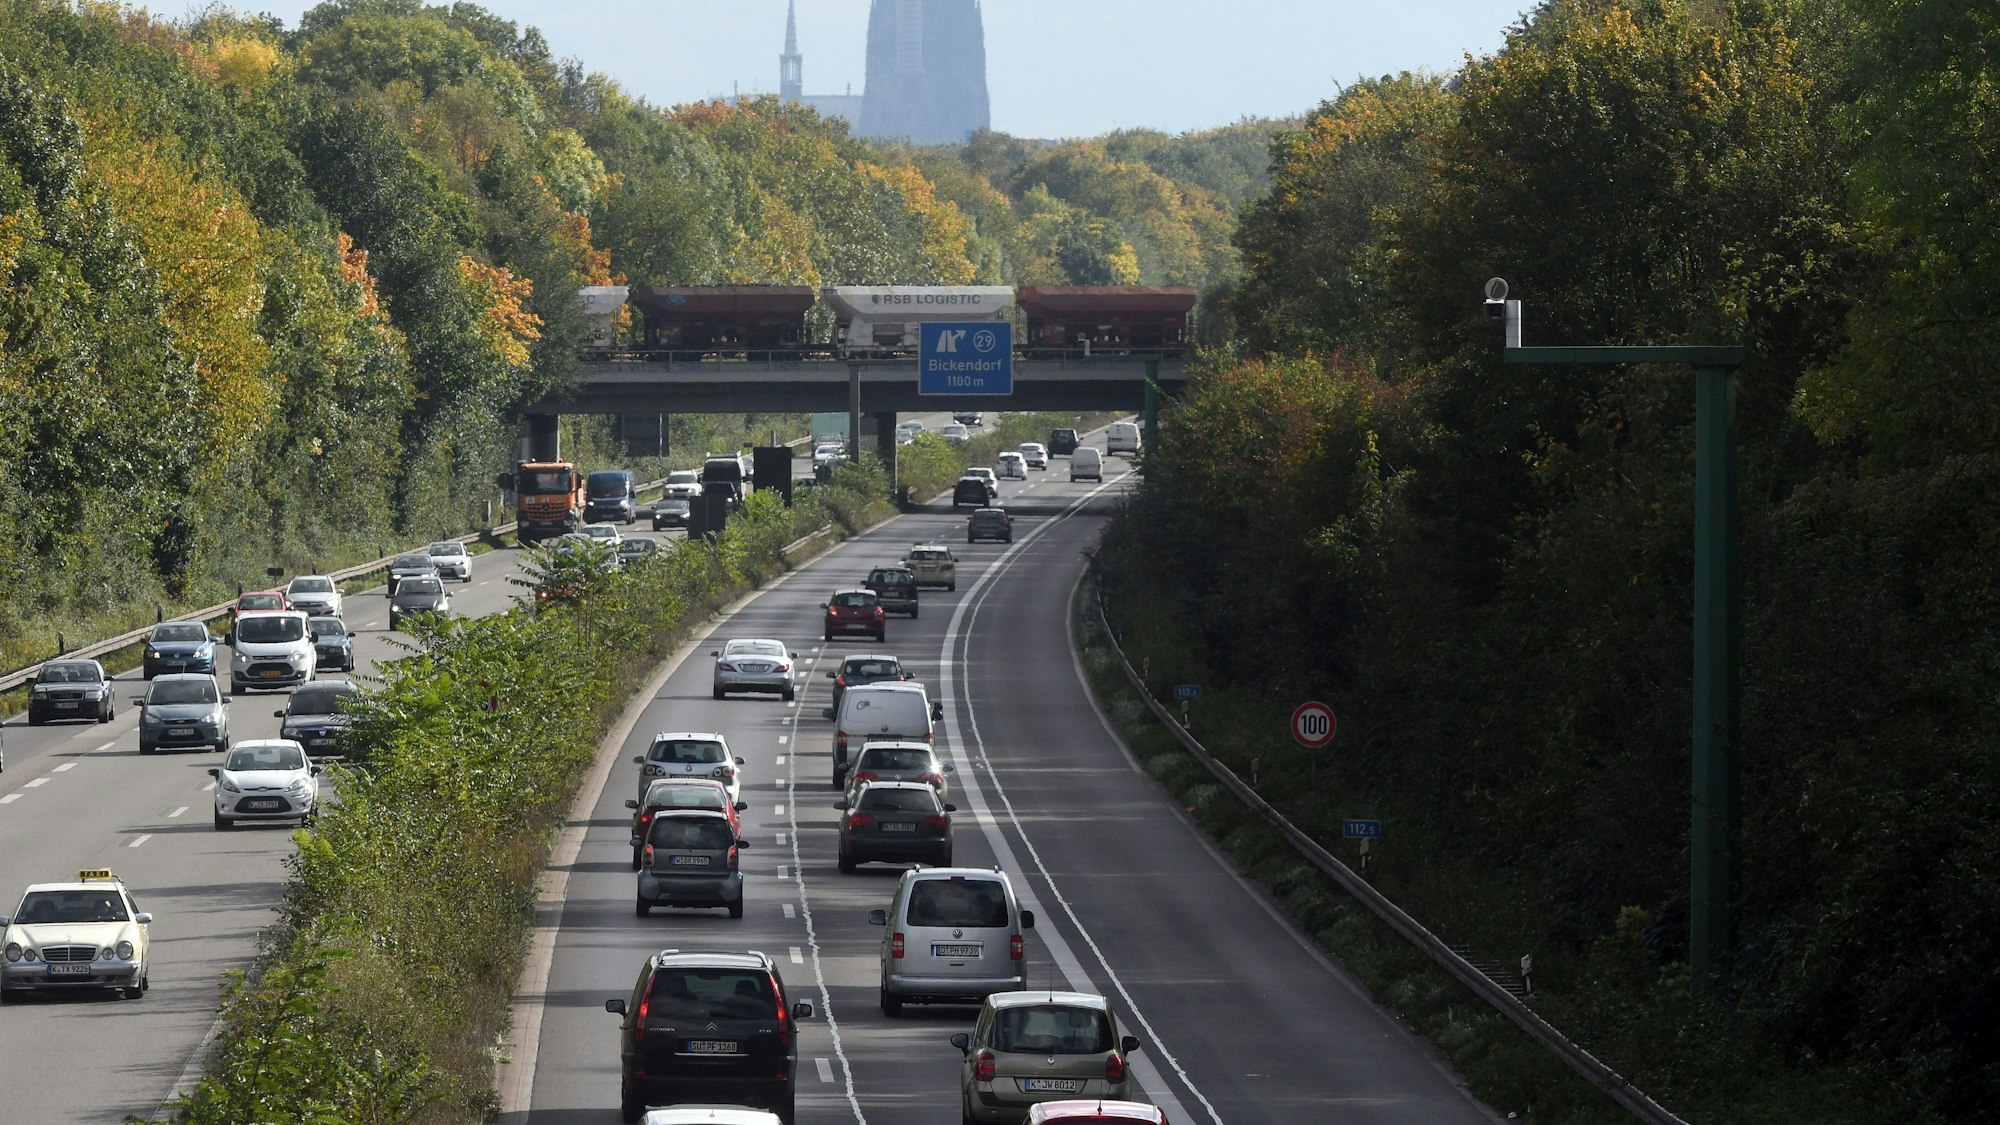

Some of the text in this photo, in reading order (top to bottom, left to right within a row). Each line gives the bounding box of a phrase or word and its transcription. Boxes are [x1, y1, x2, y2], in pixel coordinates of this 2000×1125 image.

[884, 294, 982, 304] RSB LOGISTIC
[977, 336, 991, 348] 29
[928, 359, 1002, 371] Bickendorf
[947, 376, 984, 387] 1100 m
[1301, 715, 1327, 735] 100
[71, 965, 89, 973] 9226
[692, 1042, 736, 1051] SU PF 1168
[1041, 1080, 1053, 1089] JW
[1054, 1080, 1075, 1090] 8012
